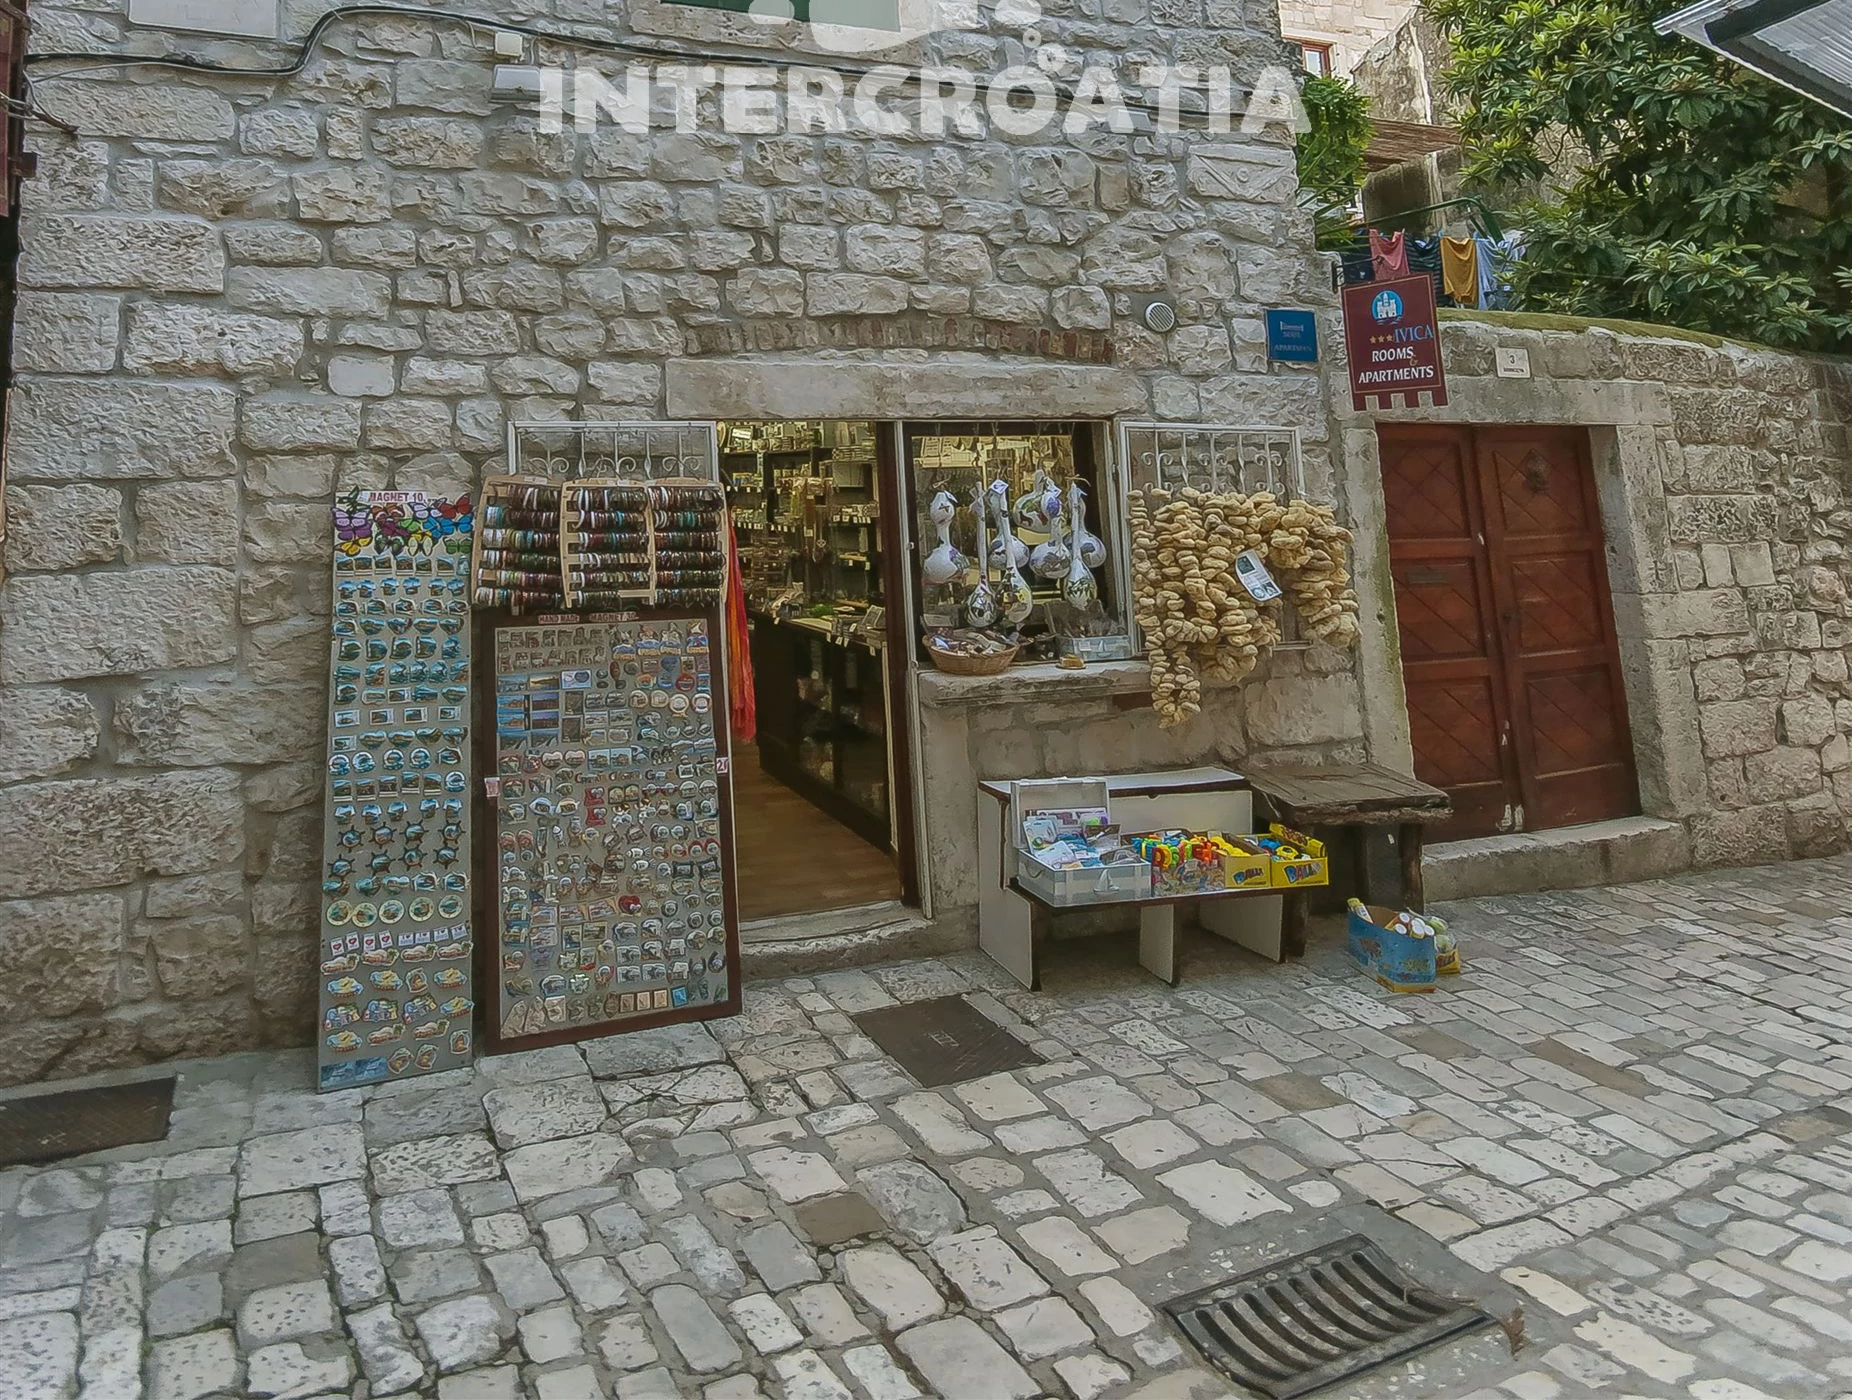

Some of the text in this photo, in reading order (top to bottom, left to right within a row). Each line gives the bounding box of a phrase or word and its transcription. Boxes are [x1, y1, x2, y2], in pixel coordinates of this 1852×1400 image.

[1394, 325, 1434, 343] IVICA
[1372, 346, 1414, 362] ROOMS
[1508, 354, 1516, 365] 3
[1359, 366, 1434, 384] APARTMENTS
[369, 492, 409, 502] MAGNET
